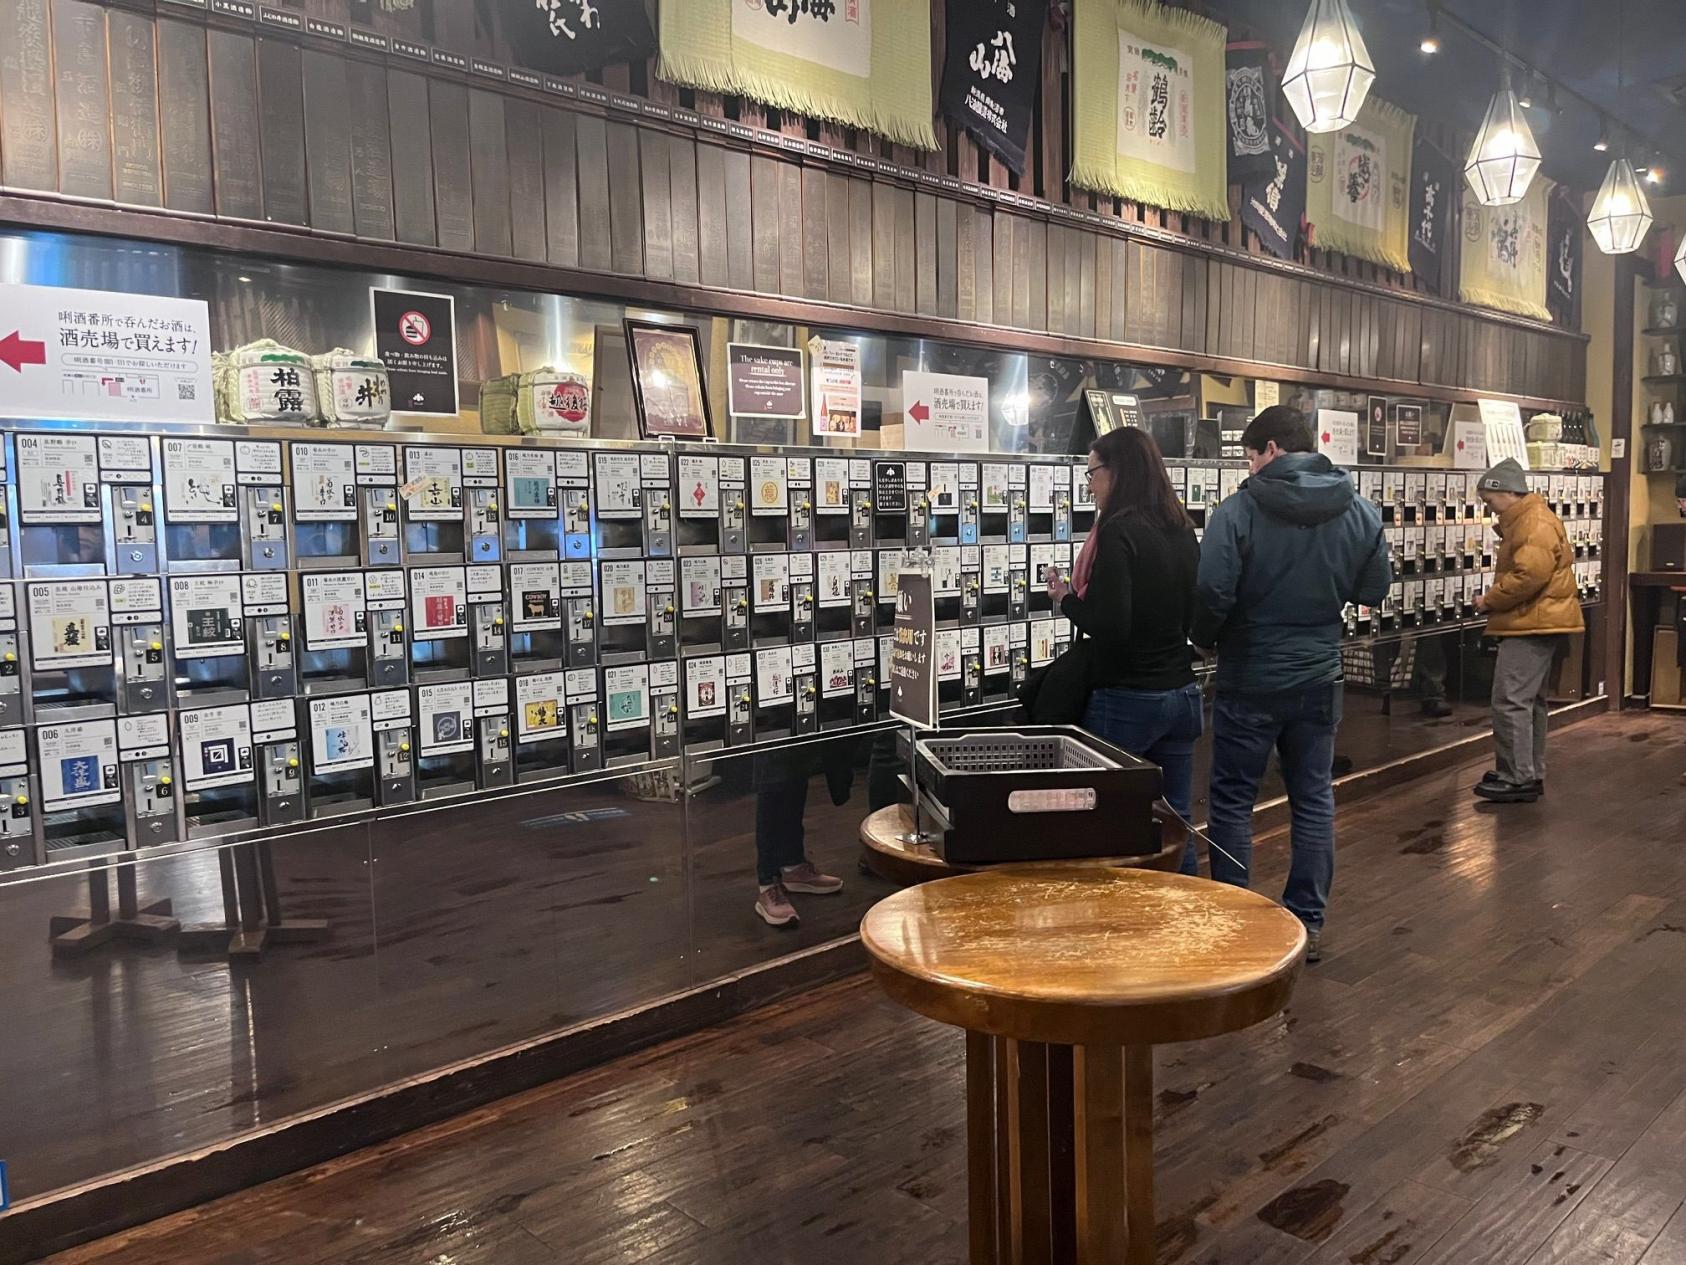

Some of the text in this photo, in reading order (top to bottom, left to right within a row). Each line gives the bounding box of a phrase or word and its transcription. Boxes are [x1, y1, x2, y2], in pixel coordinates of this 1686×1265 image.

[58, 311, 197, 334] 唎酒番所で呑んだお酒は、
[754, 356, 768, 364] sake
[768, 359, 783, 367] cups
[771, 367, 784, 375] only
[270, 367, 304, 412] 柏露
[22, 438, 38, 448] 004
[168, 442, 182, 452] 007
[295, 447, 308, 456] 010
[409, 451, 420, 459] 013
[385, 512, 395, 521] 10
[414, 572, 425, 580] 014
[513, 567, 524, 576] 017
[174, 581, 189, 590] 008
[306, 577, 318, 587] 011
[33, 586, 49, 597] 005
[391, 633, 401, 642] 11
[280, 643, 287, 651] 8
[151, 652, 158, 661] 5
[6, 665, 14, 674] 2
[421, 688, 432, 697] 015
[313, 703, 326, 712] 012
[184, 714, 198, 724] 009
[42, 729, 58, 740] 006
[288, 769, 295, 778] 9
[161, 786, 168, 796] 6
[17, 807, 25, 816] 3
